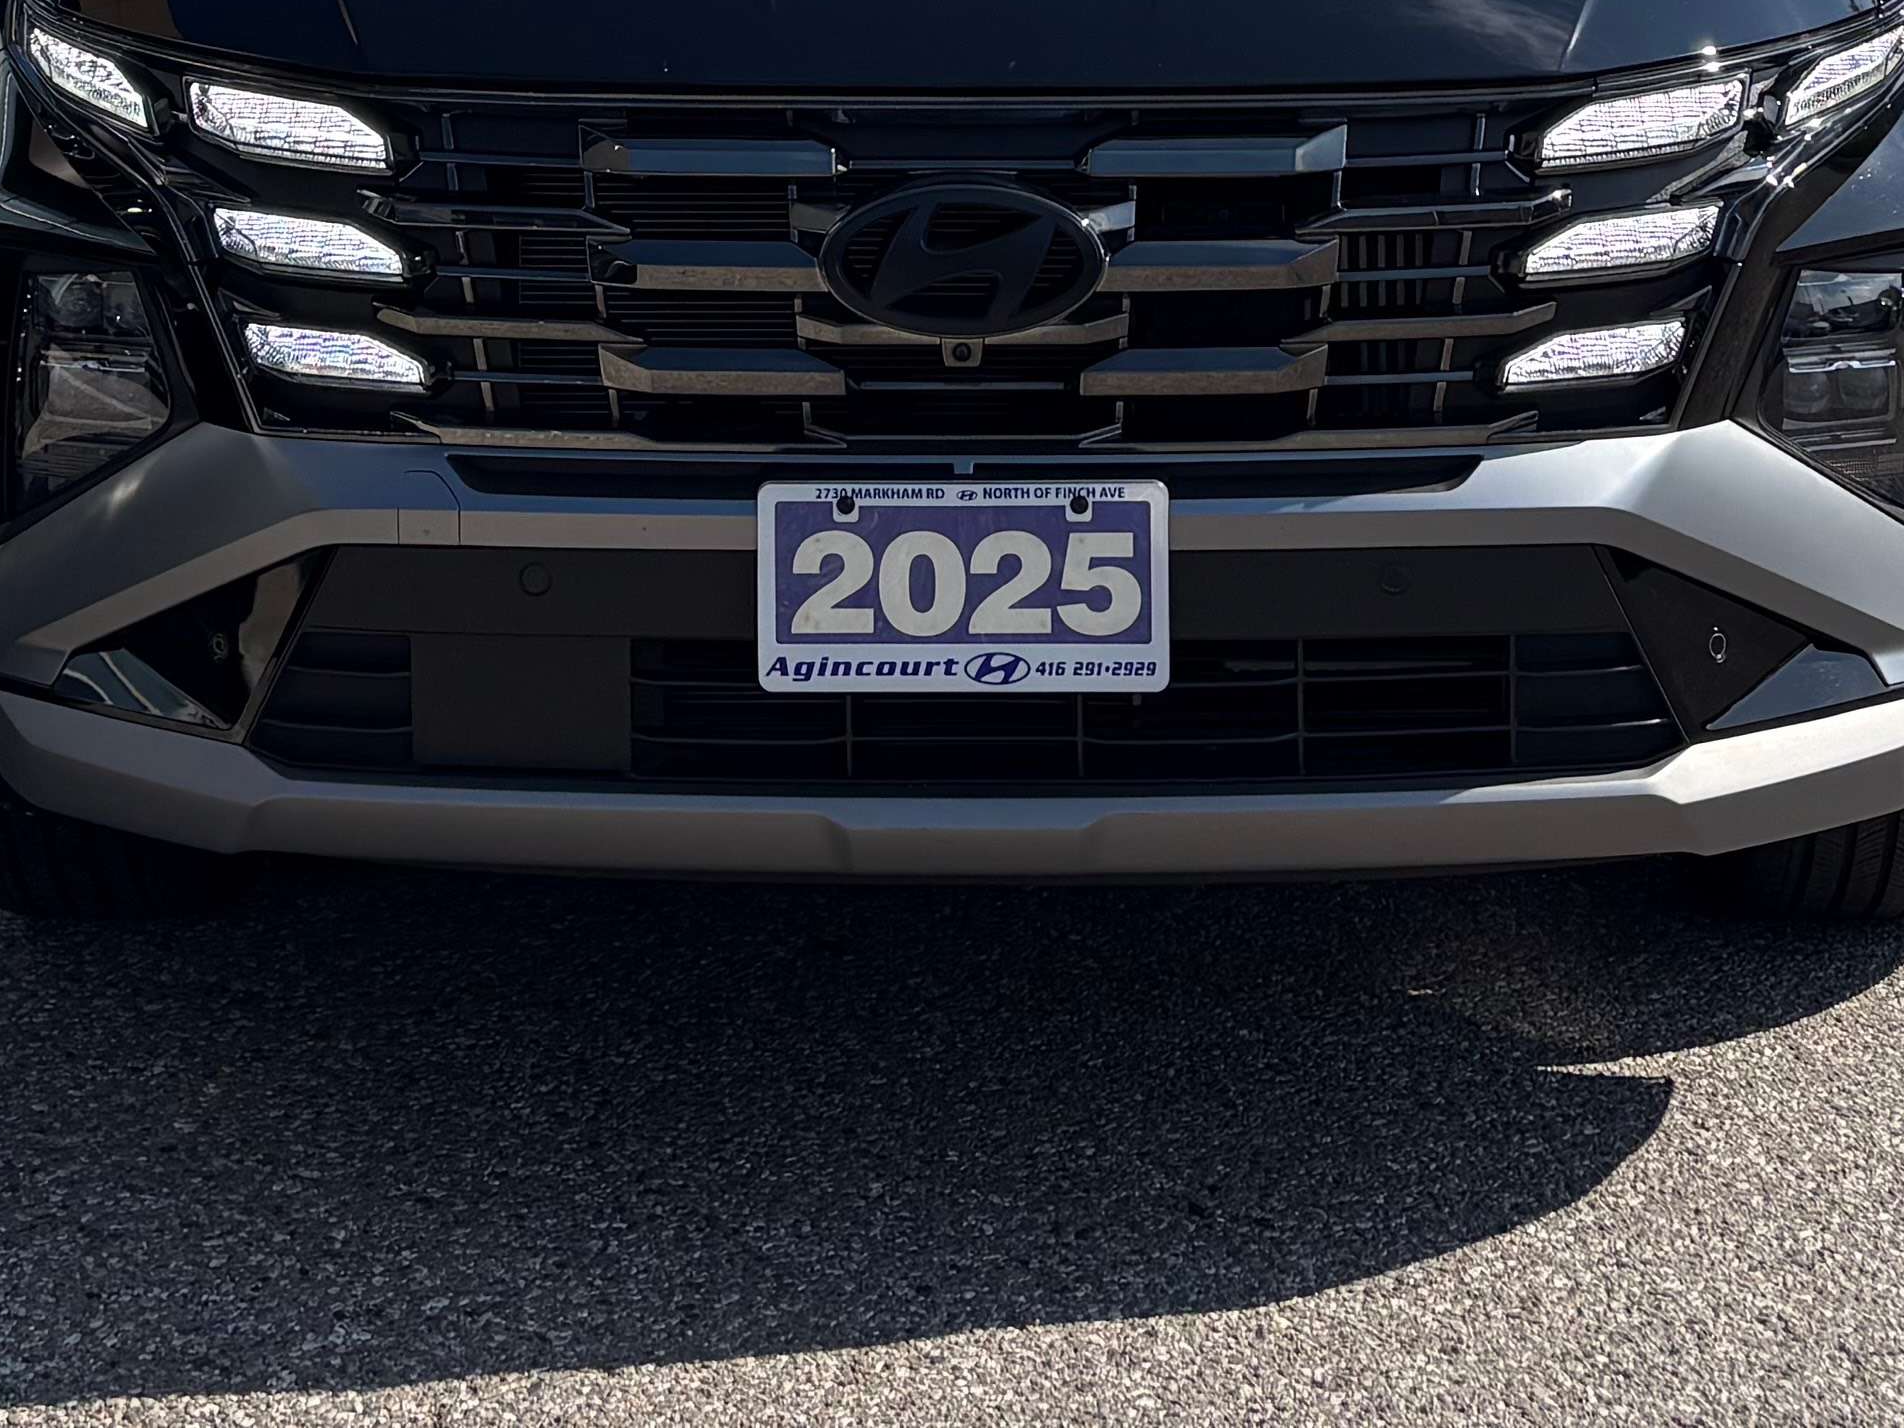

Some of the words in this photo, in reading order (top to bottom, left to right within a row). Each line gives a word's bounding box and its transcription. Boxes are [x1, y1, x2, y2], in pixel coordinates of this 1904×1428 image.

[816, 488, 847, 499] 2730
[850, 488, 923, 499] MARKHAM
[927, 488, 945, 499] RD
[983, 487, 1031, 499] NORTH
[1034, 487, 1051, 499] OF
[1055, 487, 1095, 498] FINCH
[1099, 487, 1125, 498] AVE
[791, 530, 1142, 637] 2025
[766, 656, 959, 682] Agincourt
[1035, 661, 1066, 676] 416
